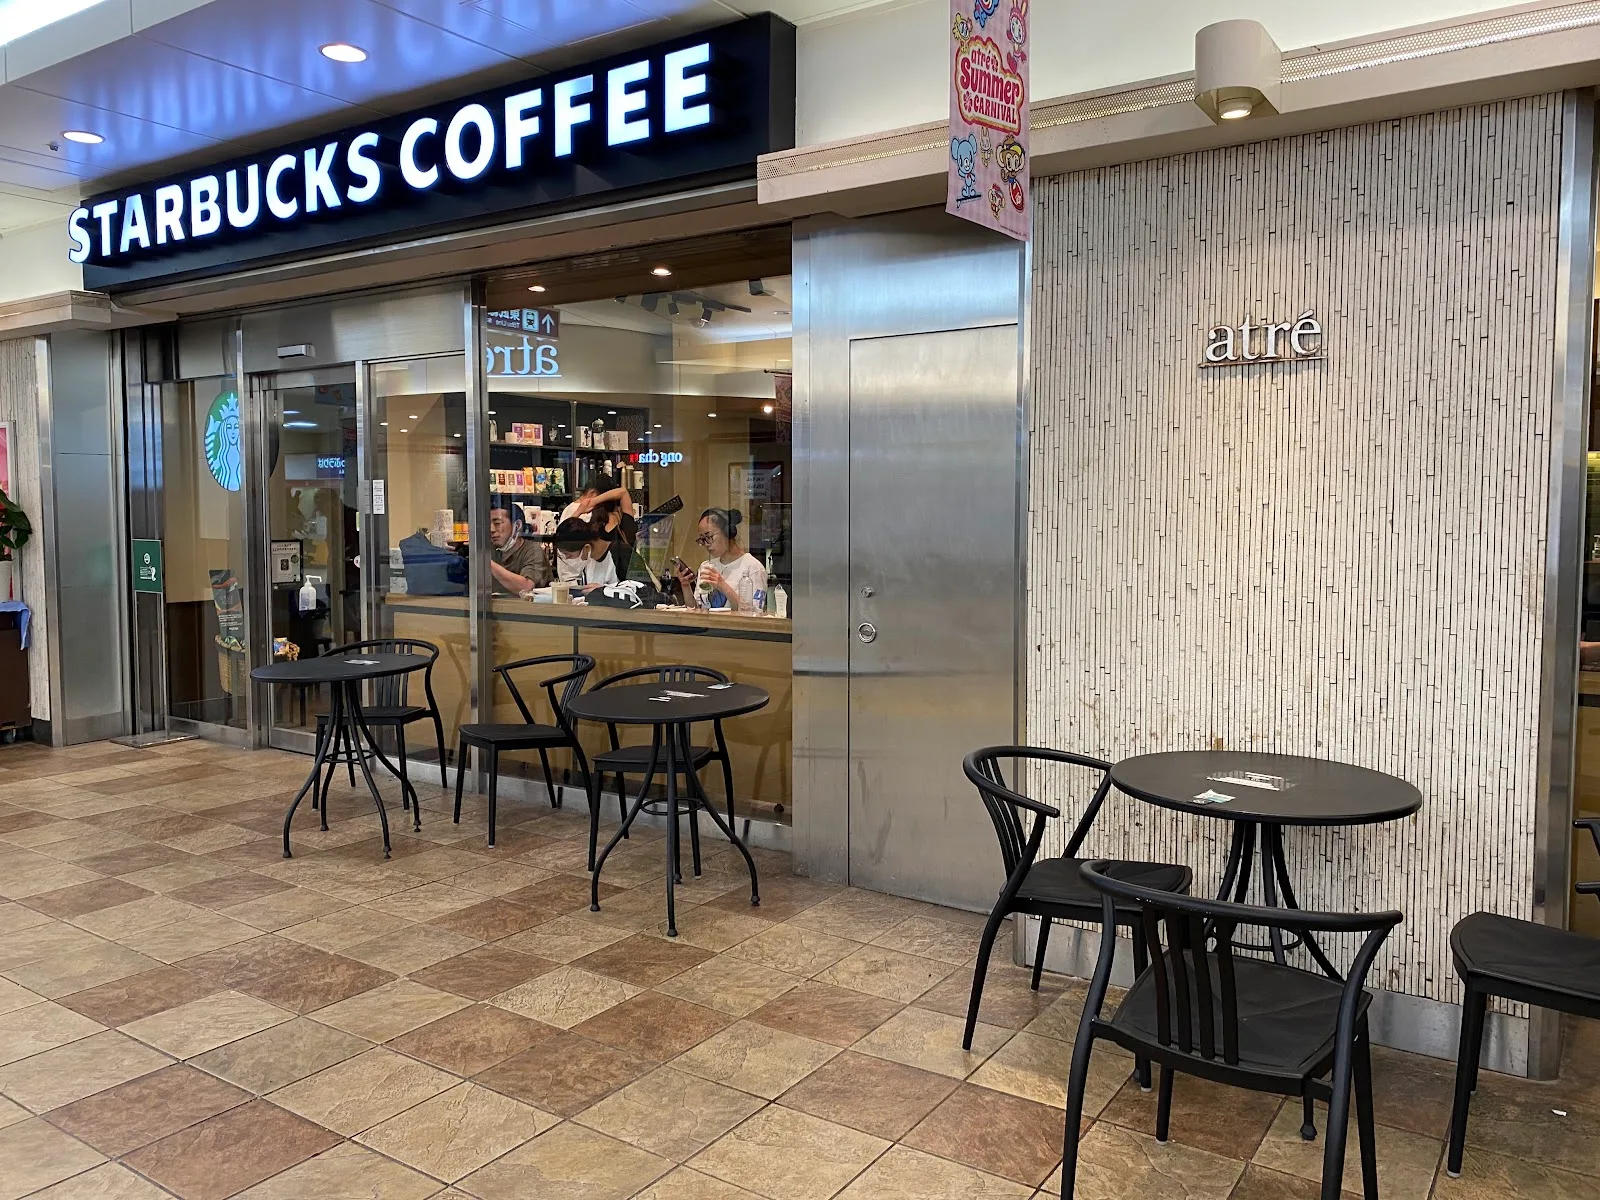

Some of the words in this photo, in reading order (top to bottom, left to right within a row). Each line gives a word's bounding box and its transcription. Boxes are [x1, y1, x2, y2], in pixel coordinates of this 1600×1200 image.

[960, 56, 1020, 105] Summer
[973, 94, 1017, 125] CARNIVAL
[68, 131, 381, 264] STARBUCKS
[399, 42, 711, 190] COFFEE
[1205, 308, 1322, 362] atré
